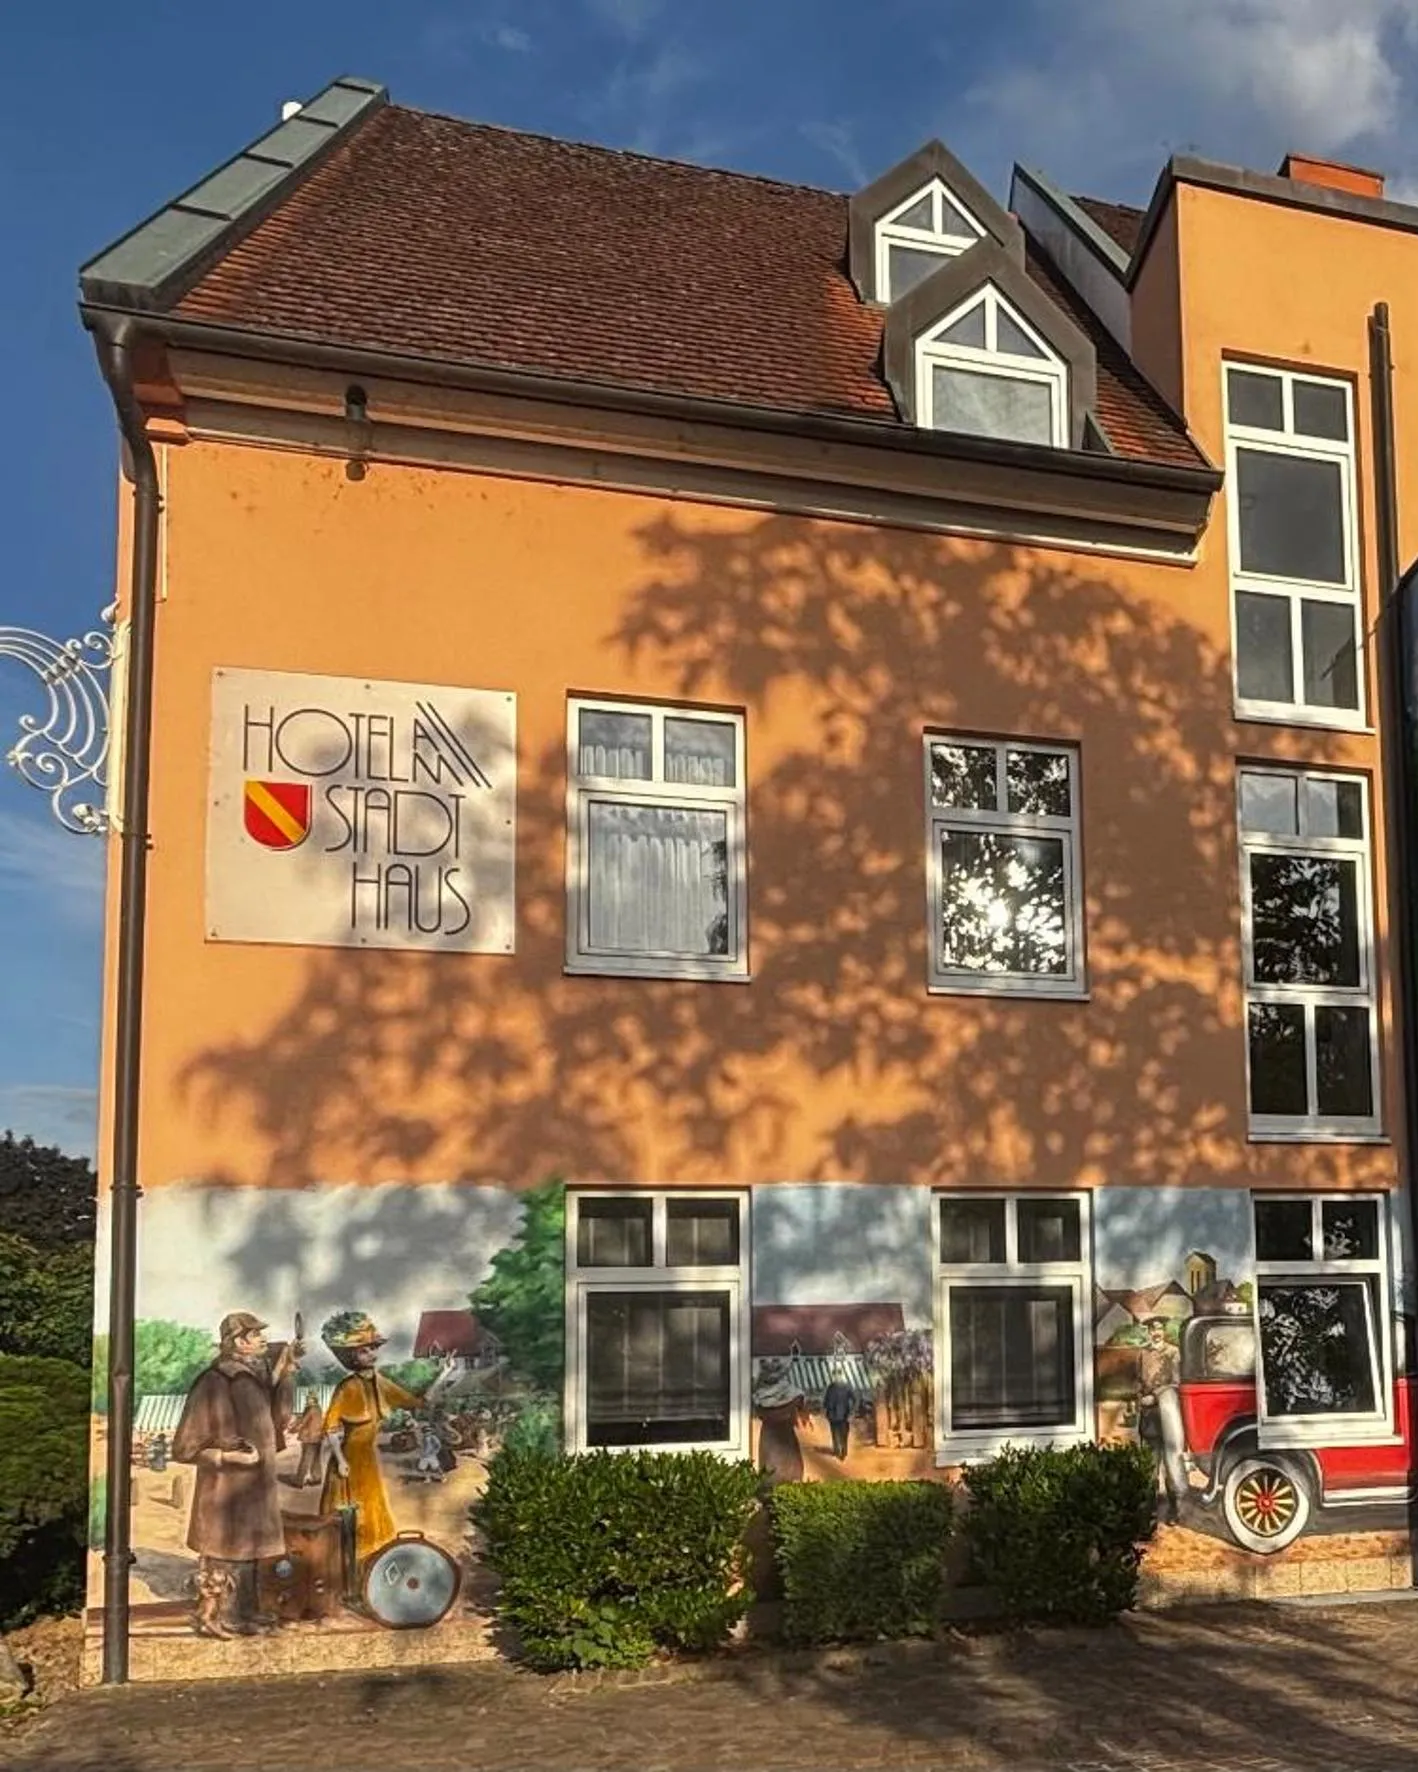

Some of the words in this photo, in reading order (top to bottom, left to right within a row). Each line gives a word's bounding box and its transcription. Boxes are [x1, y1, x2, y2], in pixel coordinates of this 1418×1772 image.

[243, 704, 409, 782] HOTEL
[412, 702, 485, 788] AM
[325, 784, 467, 859] STADT
[351, 862, 471, 935] HAUS
